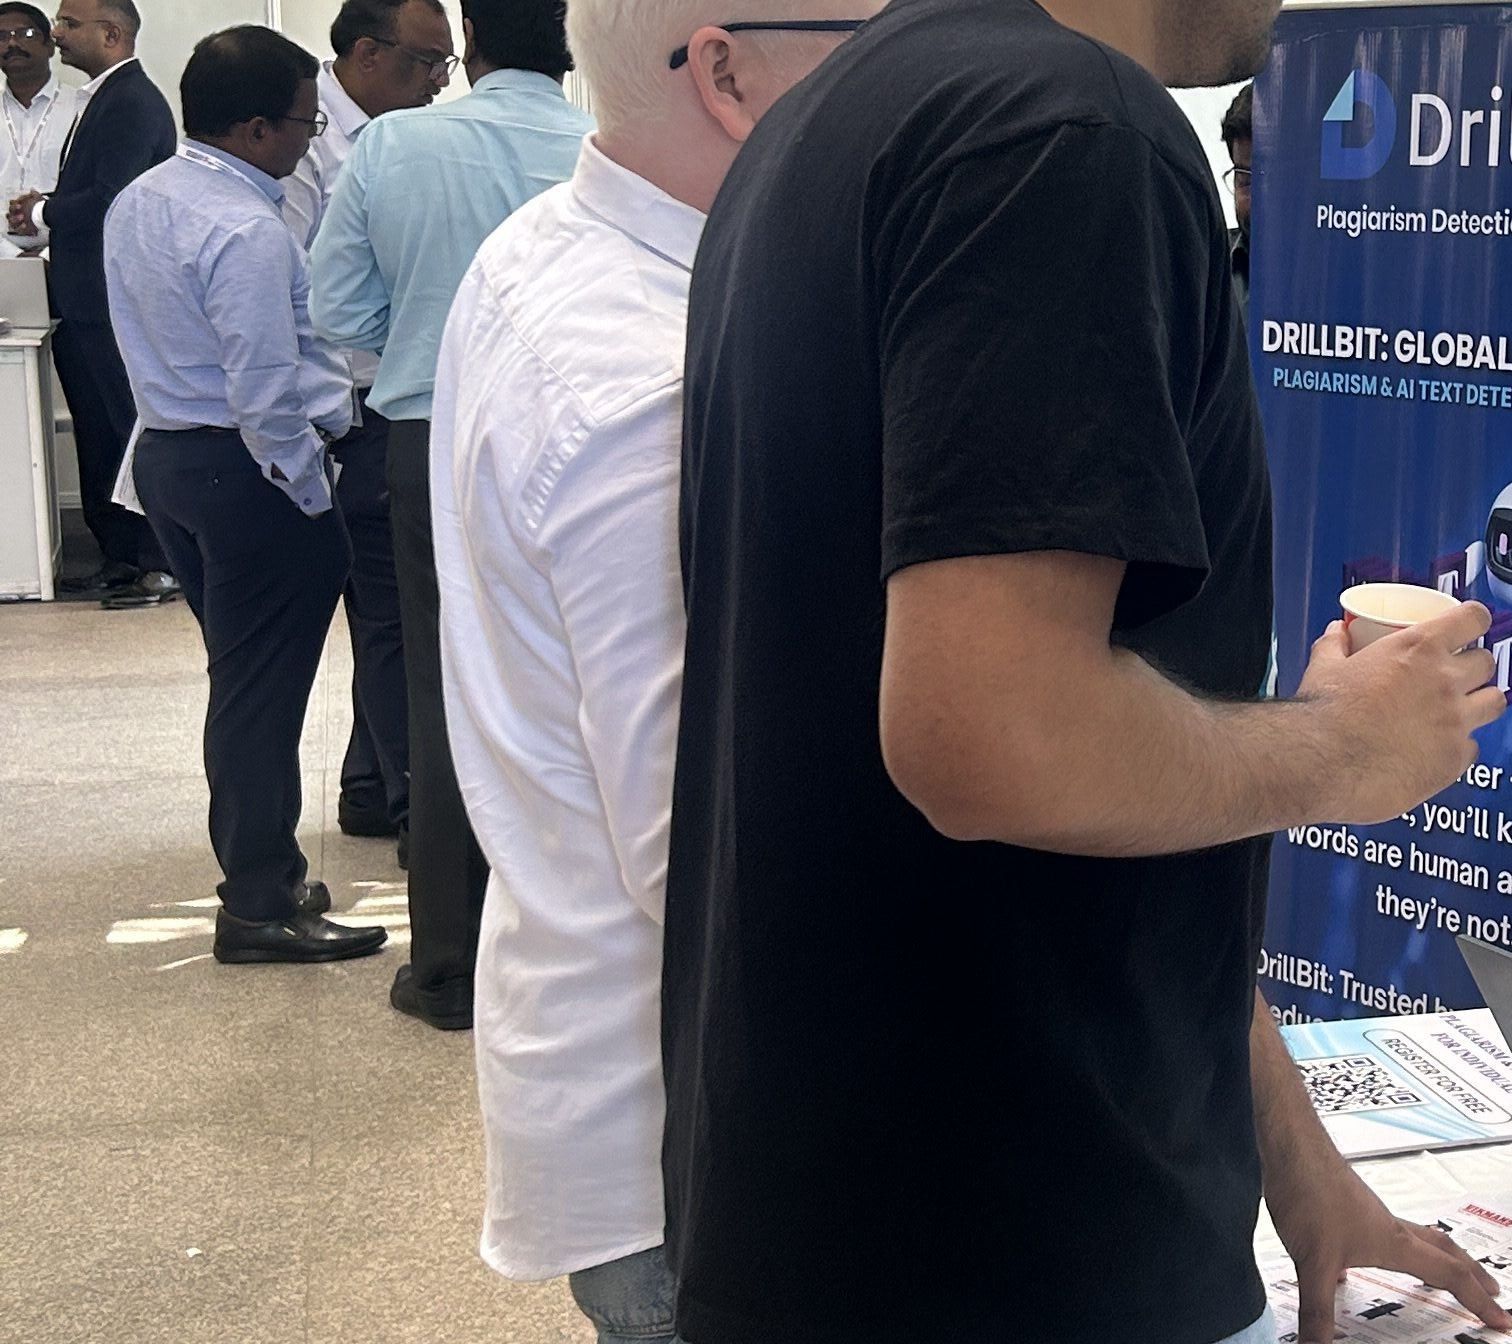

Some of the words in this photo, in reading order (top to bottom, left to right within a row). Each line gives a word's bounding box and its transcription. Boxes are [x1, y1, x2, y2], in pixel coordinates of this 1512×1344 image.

[1316, 204, 1426, 239] Plagiarism
[1262, 321, 1389, 362] DRILLBIT:
[1273, 368, 1378, 396] PLAGIARISM
[1381, 378, 1393, 397] &
[1397, 379, 1415, 400] AI
[1419, 381, 1464, 405] TEXT
[1287, 824, 1359, 857] words
[1364, 839, 1402, 867] are
[1409, 842, 1489, 890] human
[1339, 969, 1429, 1014] Trusted
[1430, 1033, 1461, 1049] FOR
[1381, 1038, 1440, 1076] REGISTER
[1431, 1075, 1464, 1092] FOR
[1452, 1093, 1493, 1114] FREE
